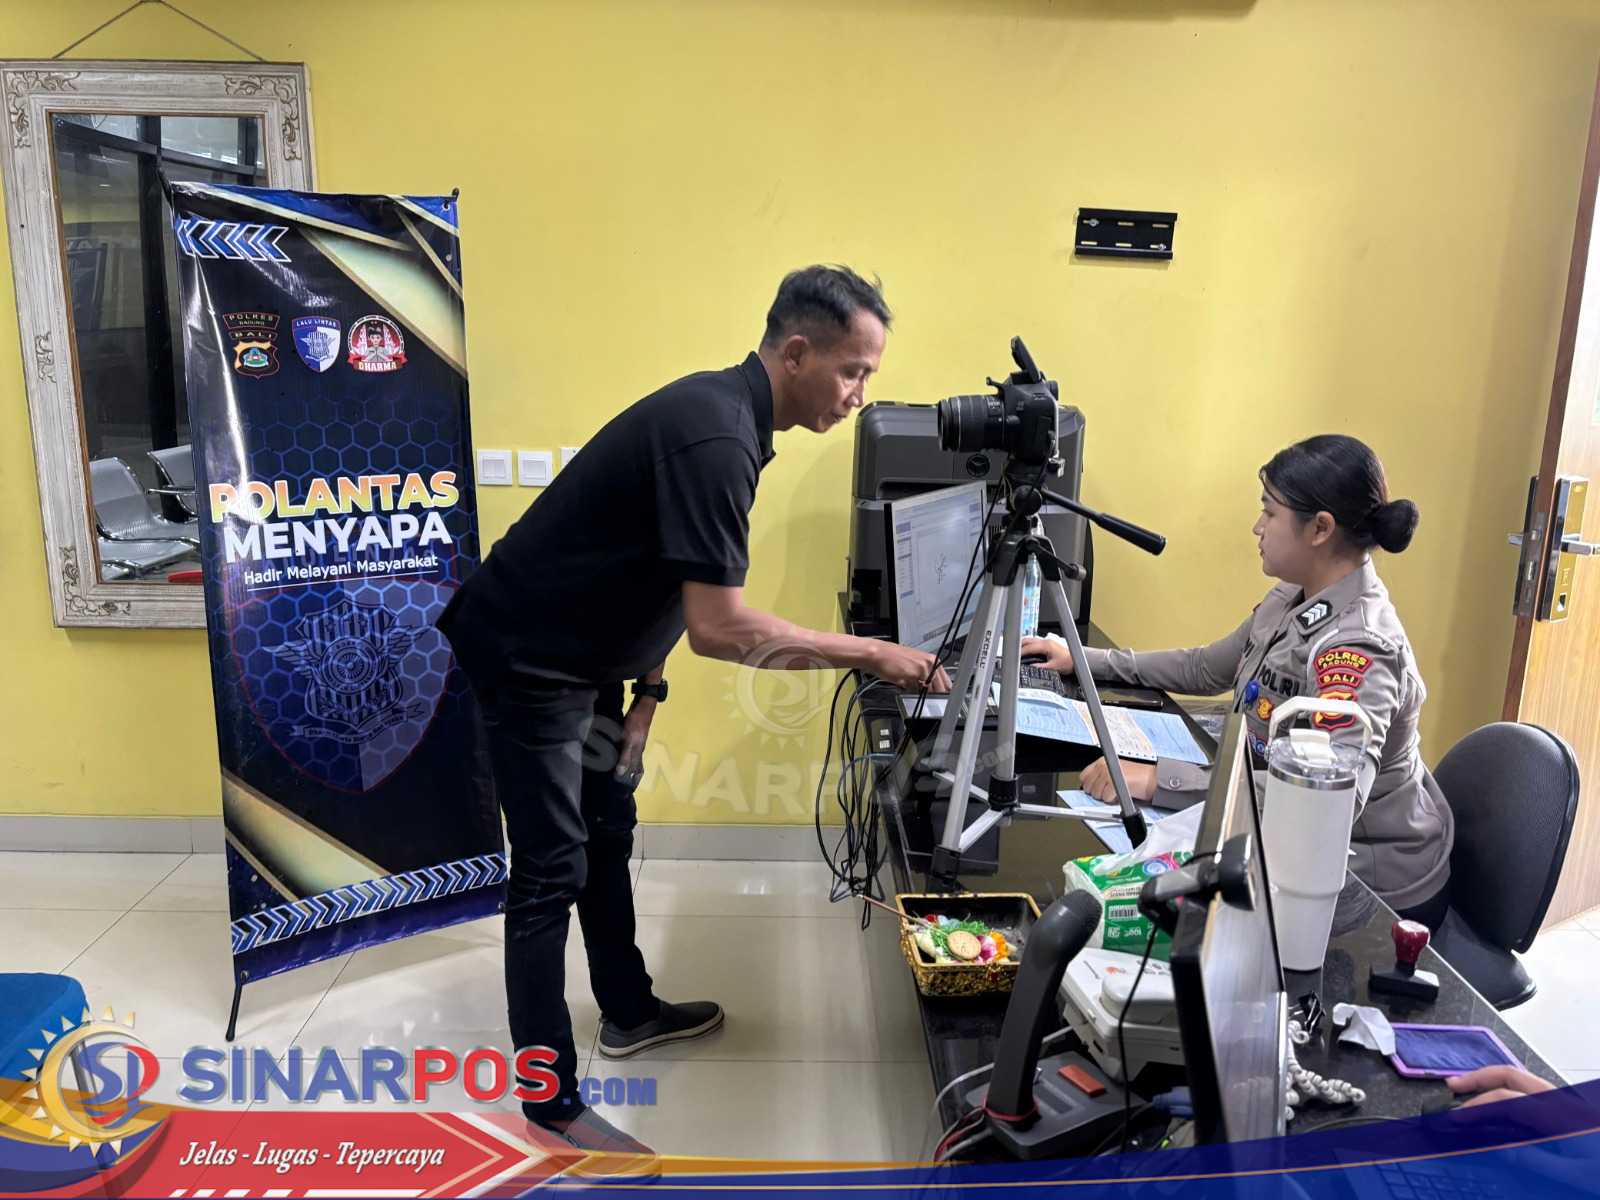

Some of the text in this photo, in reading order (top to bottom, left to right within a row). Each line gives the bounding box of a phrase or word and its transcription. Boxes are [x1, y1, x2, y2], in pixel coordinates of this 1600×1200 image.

[296, 319, 337, 328] LALU LINTAS
[358, 360, 397, 372] DHARMA
[208, 470, 460, 524] POLANTAS
[222, 511, 453, 564] MENYAPA
[243, 568, 283, 585] Hadir
[286, 562, 352, 581] Melayani
[356, 553, 439, 574] Masyarakat
[1317, 651, 1368, 667] POLRES
[1323, 673, 1355, 684] BALI
